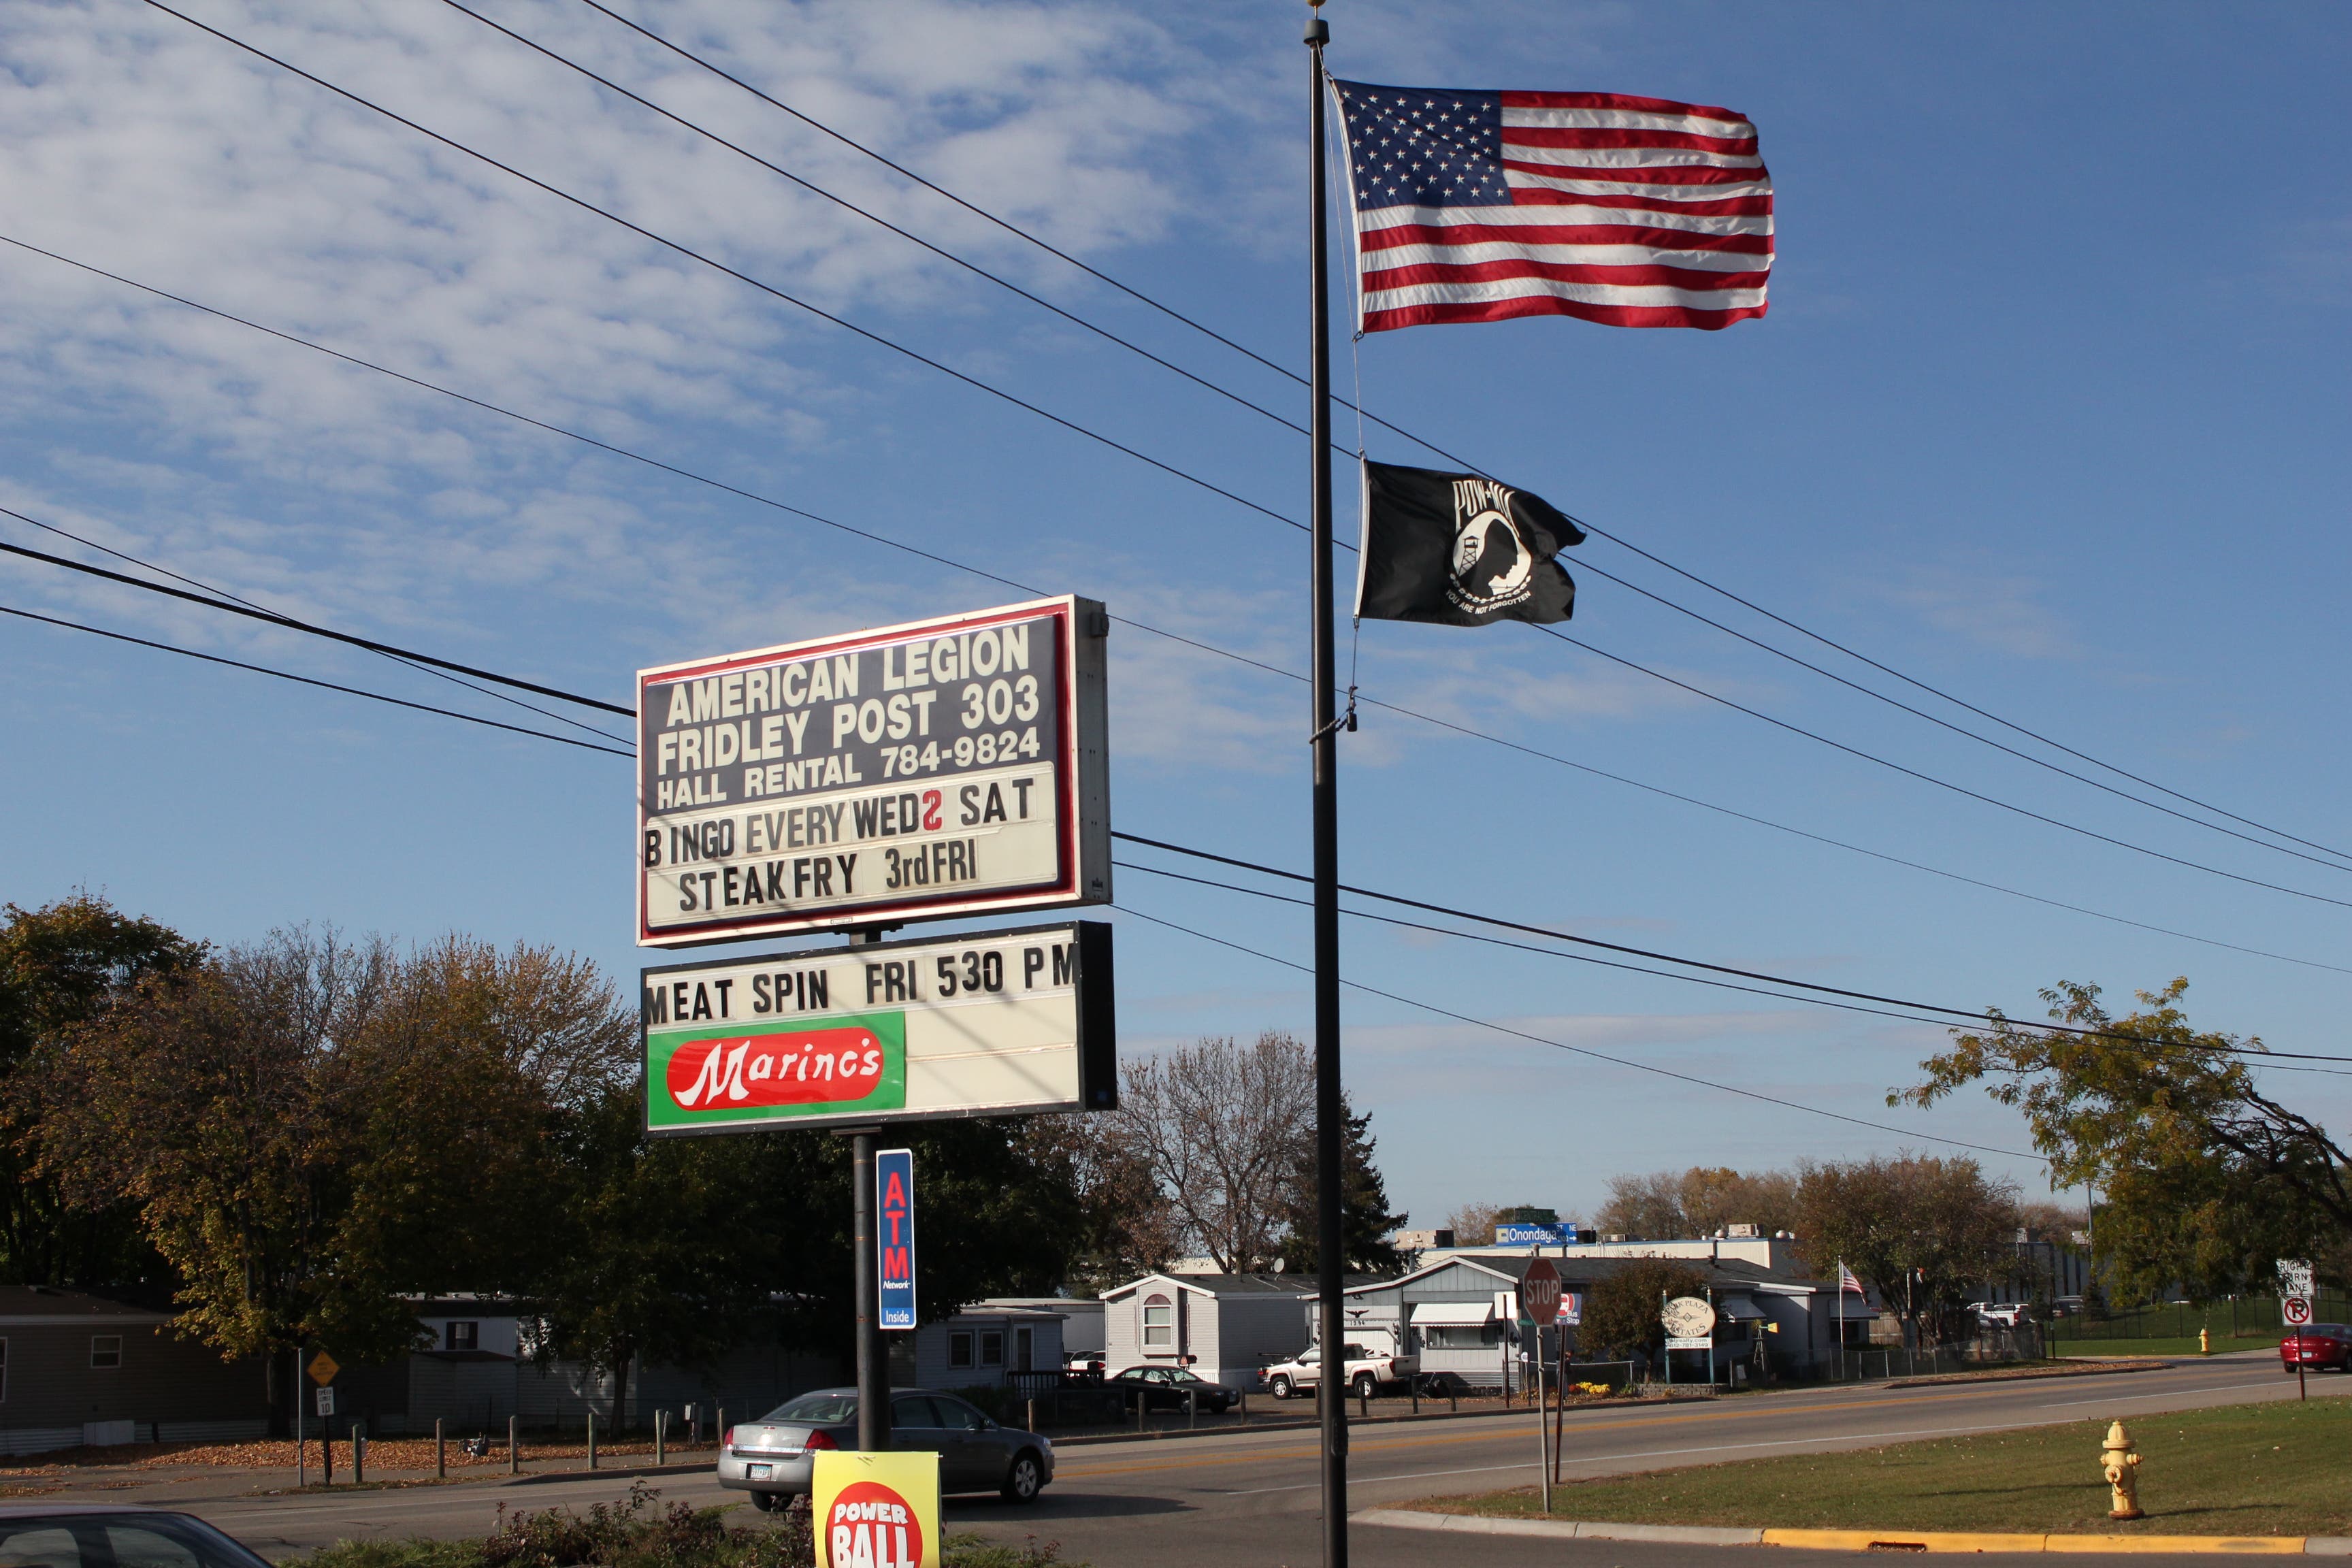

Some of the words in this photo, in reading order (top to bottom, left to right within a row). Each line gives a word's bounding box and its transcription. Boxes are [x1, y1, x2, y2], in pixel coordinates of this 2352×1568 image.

[1452, 480, 1487, 534] POW
[1446, 589, 1460, 604] YOU
[1459, 600, 1474, 613] ARE
[1475, 605, 1487, 615] NOT
[1488, 590, 1531, 611] FORGOTTEN
[666, 653, 859, 728] AMERICAN
[883, 625, 1029, 692] LEGION
[657, 710, 811, 775] FRIDLEY
[833, 689, 936, 749] POST
[962, 674, 1039, 730] 303
[657, 773, 726, 811] HALL
[745, 753, 862, 798] RENTAL
[881, 727, 1040, 778] 784-9824
[644, 818, 735, 868] BINGO
[747, 802, 845, 853] EVERY
[960, 777, 1034, 826] SAT
[647, 979, 733, 1024] MEAT
[753, 969, 828, 1013] SPIN
[866, 960, 916, 1004] FRI
[936, 950, 1003, 998] 530
[1024, 943, 1077, 989] PM
[883, 1172, 909, 1279] ATM
[1509, 1228, 1557, 1243] Onondaga
[883, 1280, 909, 1289] Network
[1526, 1279, 1559, 1305] STOP
[885, 1309, 909, 1323] Inside
[1684, 1301, 1708, 1314] PLAZA
[1669, 1322, 1706, 1336] ESTATES
[321, 1403, 330, 1414] 10
[834, 1502, 909, 1524] POWER
[832, 1523, 915, 1568] BALL
